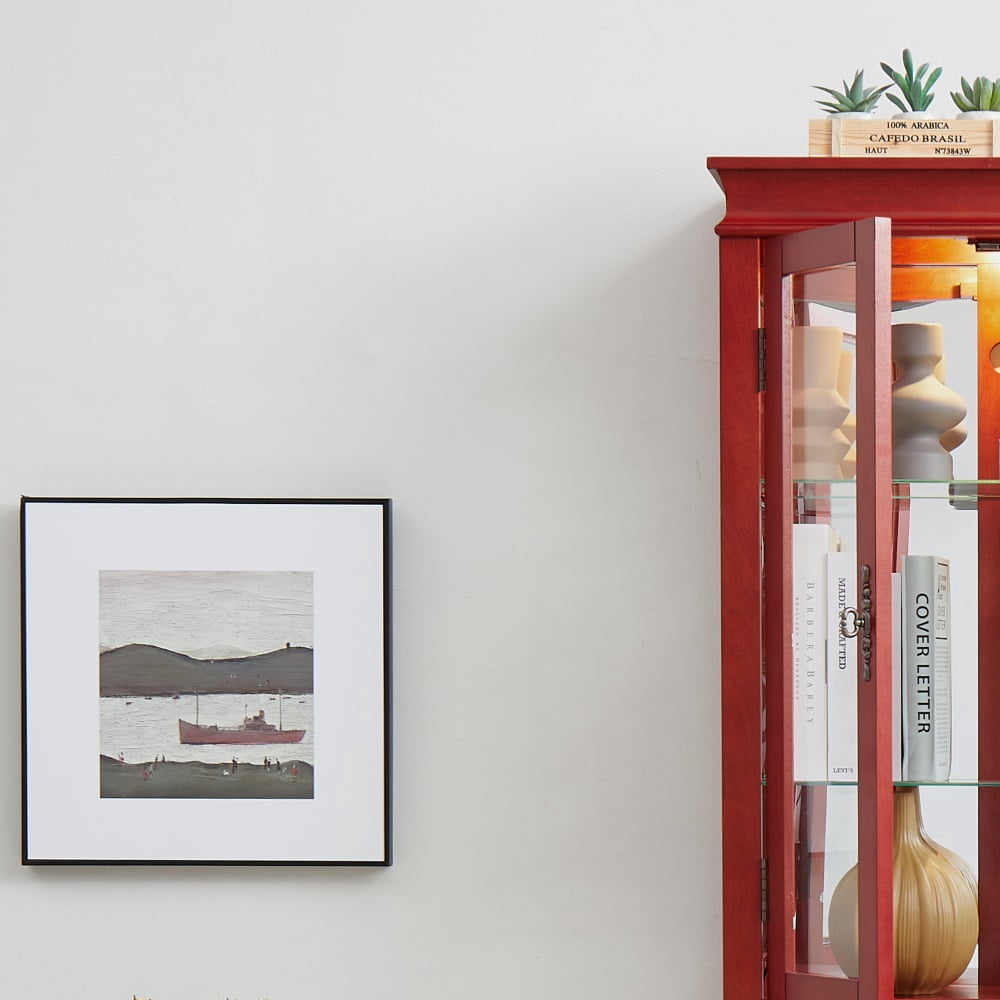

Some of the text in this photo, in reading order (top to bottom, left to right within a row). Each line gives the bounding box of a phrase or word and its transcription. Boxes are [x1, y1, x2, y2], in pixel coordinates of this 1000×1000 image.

[922, 134, 967, 143] BRASIL
[838, 577, 846, 609] MADE
[915, 593, 931, 734] COVER LETTER
